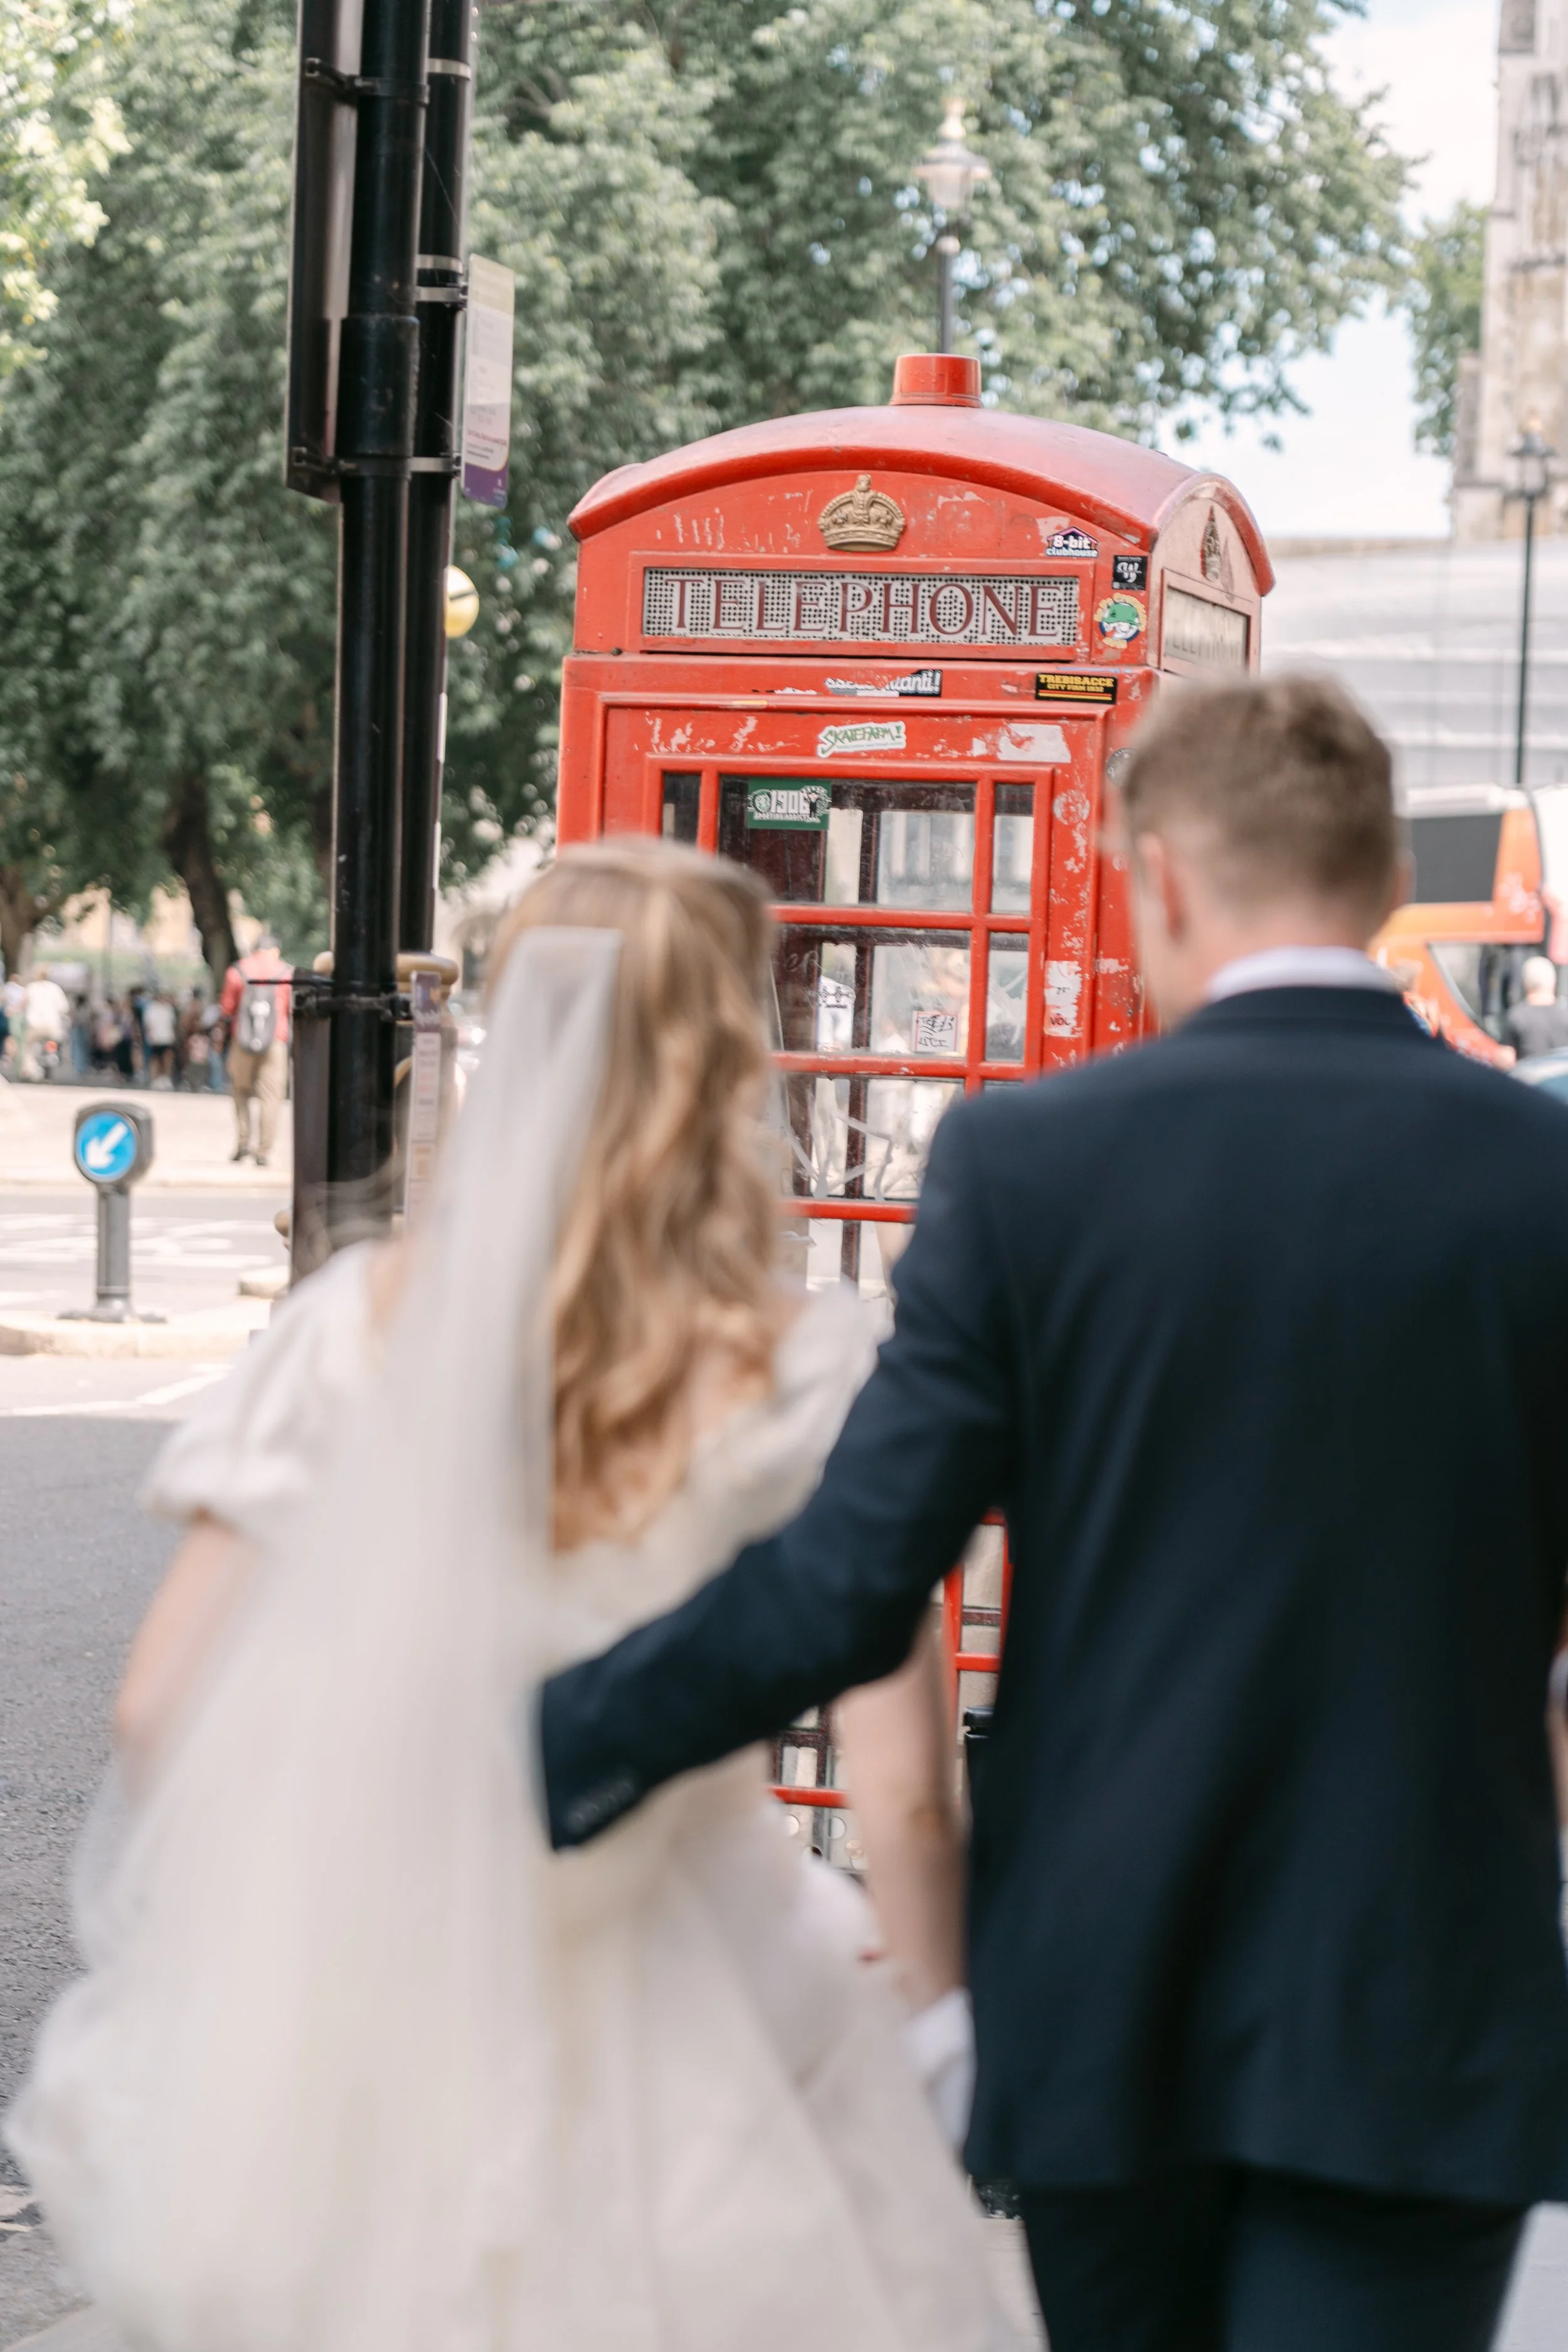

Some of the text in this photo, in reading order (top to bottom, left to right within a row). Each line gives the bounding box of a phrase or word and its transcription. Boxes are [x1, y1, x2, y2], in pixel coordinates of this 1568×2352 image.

[1053, 534, 1091, 549] 8-bit
[1046, 546, 1098, 558] clubhouse
[665, 578, 1061, 637] TELEPHONE
[1038, 674, 1114, 687] TREBISACCE
[770, 790, 811, 814] 1906
